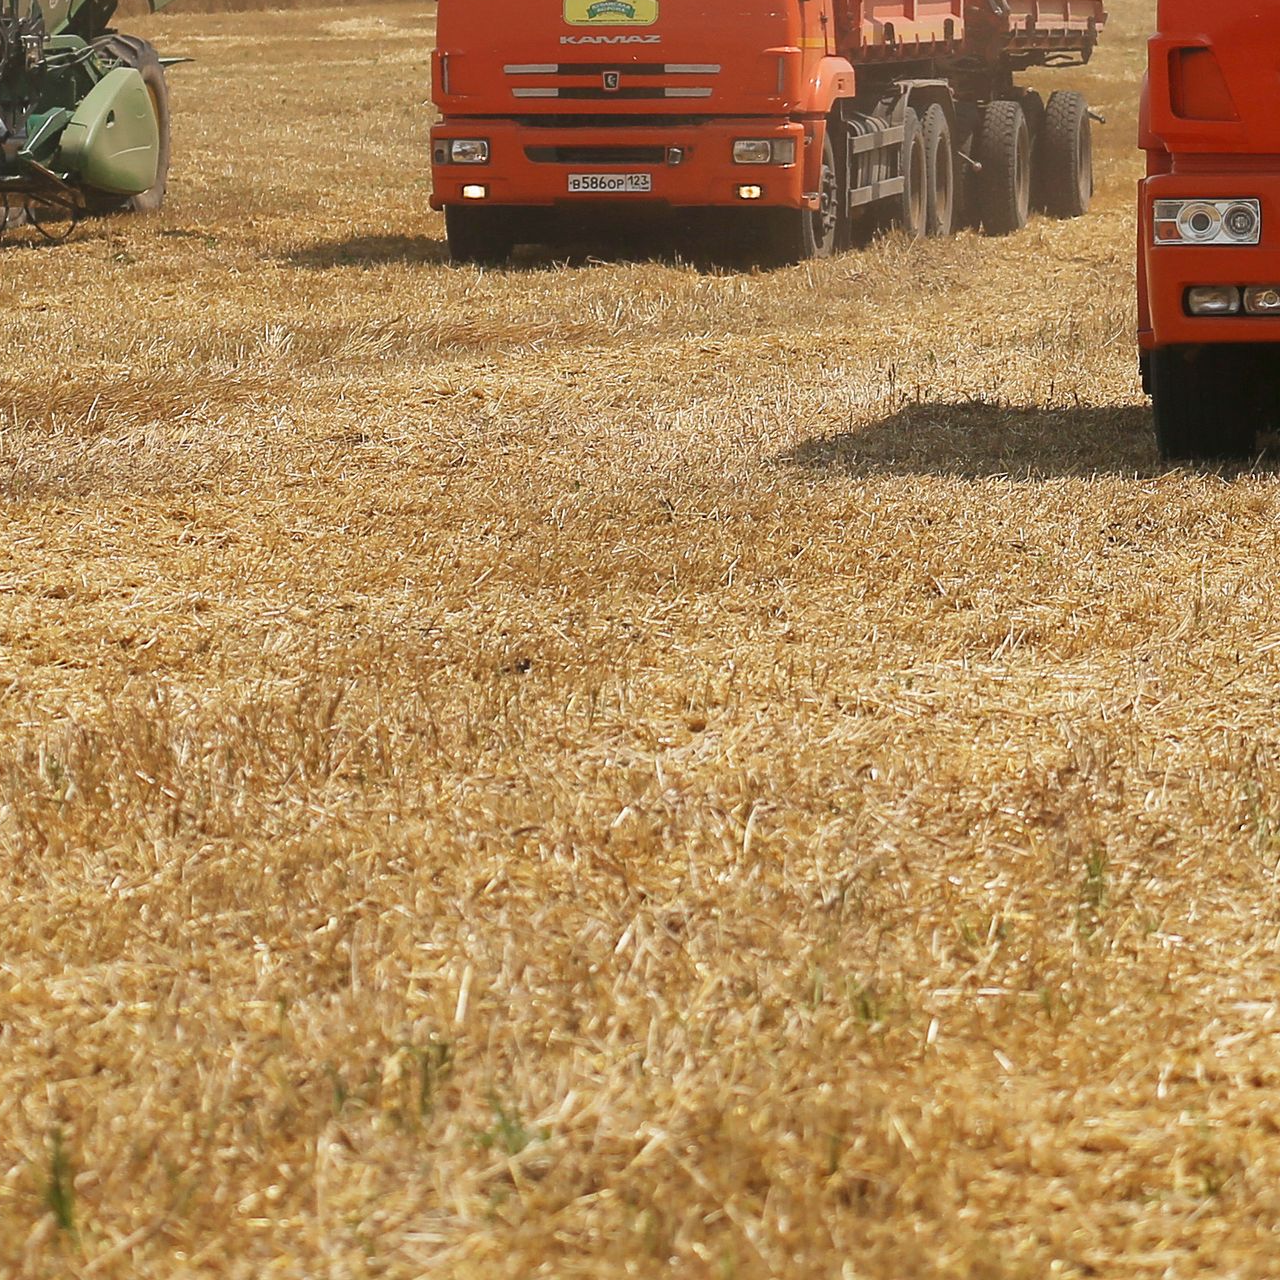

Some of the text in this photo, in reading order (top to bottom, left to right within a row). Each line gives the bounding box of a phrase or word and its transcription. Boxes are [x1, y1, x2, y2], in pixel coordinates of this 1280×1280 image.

[560, 34, 661, 44] KAMAZ
[572, 175, 647, 190] В586ОР 123
